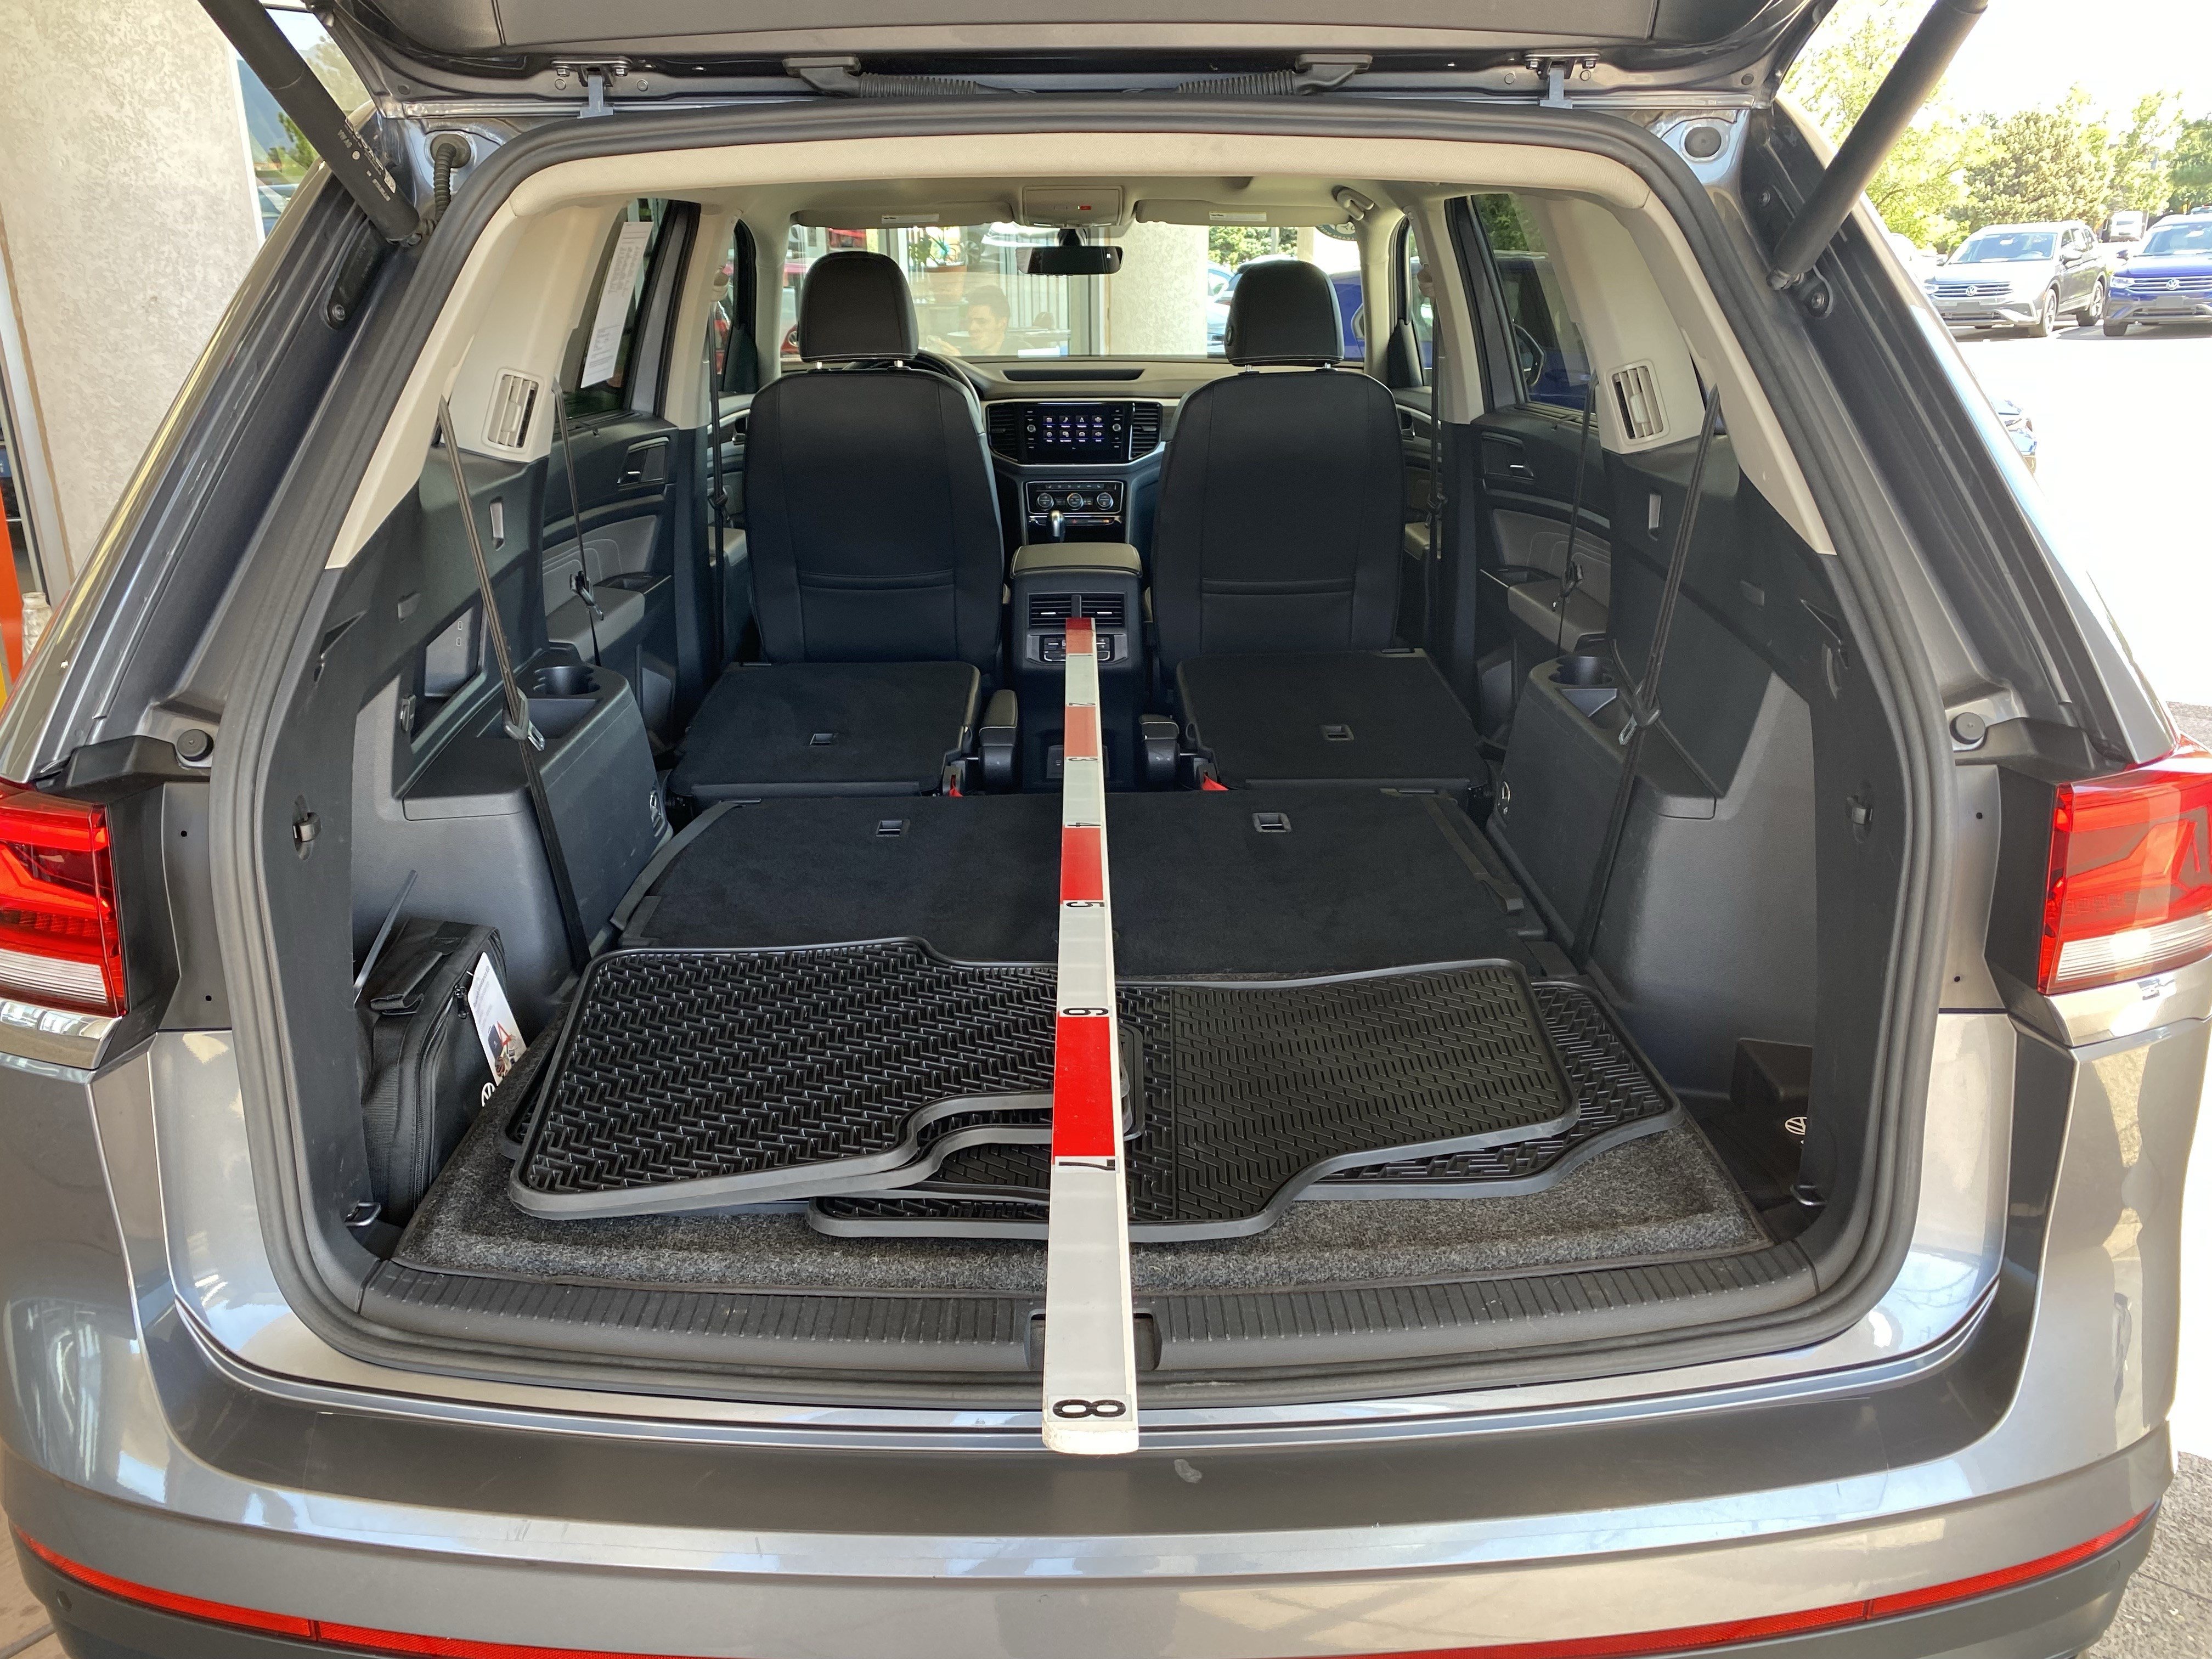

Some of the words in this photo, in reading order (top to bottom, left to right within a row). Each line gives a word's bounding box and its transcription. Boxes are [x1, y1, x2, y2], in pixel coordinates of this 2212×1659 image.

[1063, 1007, 1109, 1015] 6
[1058, 1159, 1116, 1171] 7
[1052, 1399, 1126, 1418] 8
